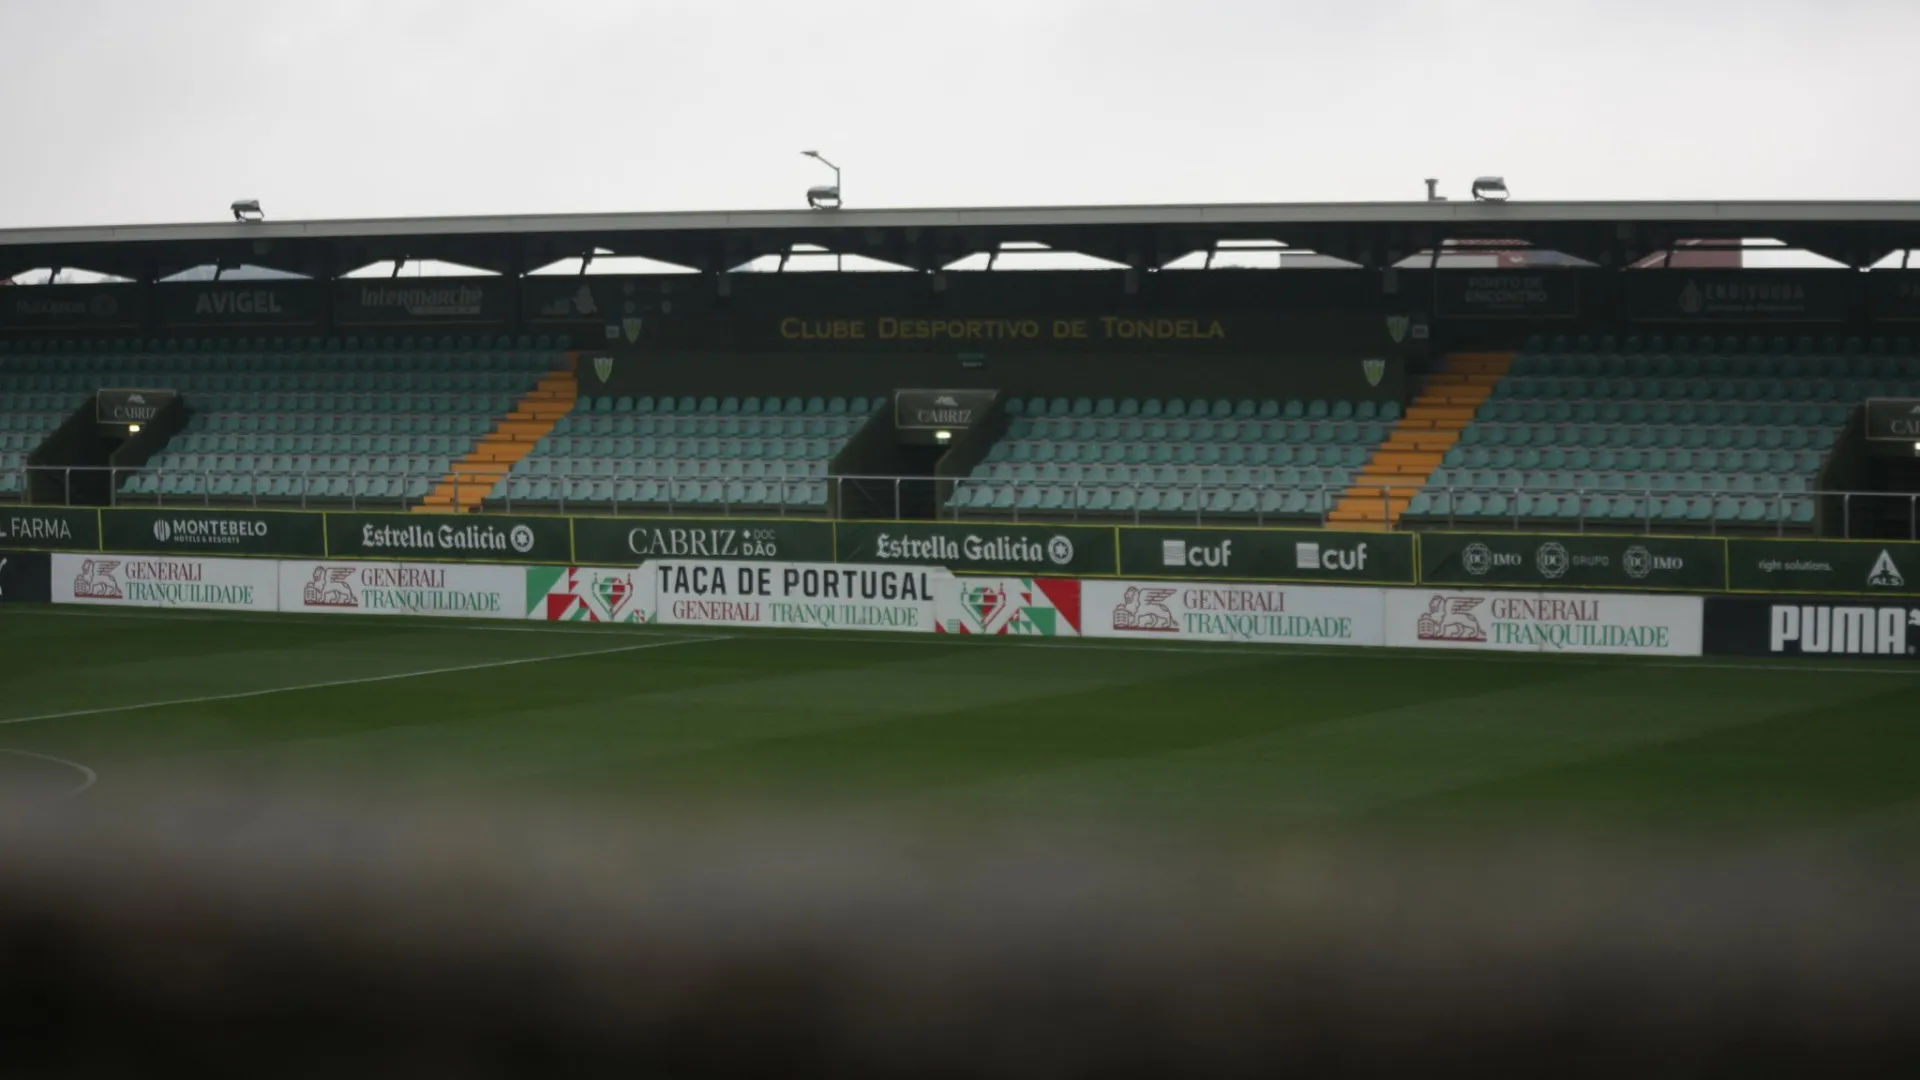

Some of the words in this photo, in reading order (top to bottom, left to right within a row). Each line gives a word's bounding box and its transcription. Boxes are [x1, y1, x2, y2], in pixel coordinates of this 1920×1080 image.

[195, 290, 283, 314] AVIGEL
[918, 408, 972, 424] CABRIZ
[11, 516, 72, 540] FARMA
[173, 519, 268, 537] MONTEBELO
[362, 523, 435, 549] Estrella
[438, 524, 508, 552] Galicia
[174, 536, 201, 544] HOTELS
[208, 536, 240, 545] RESORTS
[628, 527, 738, 556] CABRIZ
[743, 541, 777, 557] DÃO
[876, 532, 960, 560] Estrella
[964, 534, 1043, 563] Galicia
[1189, 539, 1232, 567] cuf
[1323, 543, 1368, 571] cuf
[1493, 552, 1521, 566] IMO
[1572, 556, 1609, 567] GRUPO
[1653, 556, 1683, 571] IMO
[125, 562, 202, 582] GENERALI
[361, 567, 446, 589] GENERALI
[1758, 559, 1782, 573] right
[126, 582, 254, 605] TRANQUILIDADE
[658, 565, 727, 596] TAÇA
[738, 567, 771, 596] DE
[784, 568, 933, 601] PORTUGAL
[1871, 577, 1901, 587] ALS
[361, 590, 500, 613] TRANQUILIDADE
[1183, 588, 1285, 613] GENERALI
[1491, 598, 1599, 622] GENERALI
[672, 601, 760, 622] GENERALI
[768, 602, 919, 627] TRANQUILIDADE
[1183, 612, 1352, 640] TRANQUILIDADE
[1491, 622, 1669, 650] TRANQUILIDADE
[1770, 605, 1906, 655] PUMA
